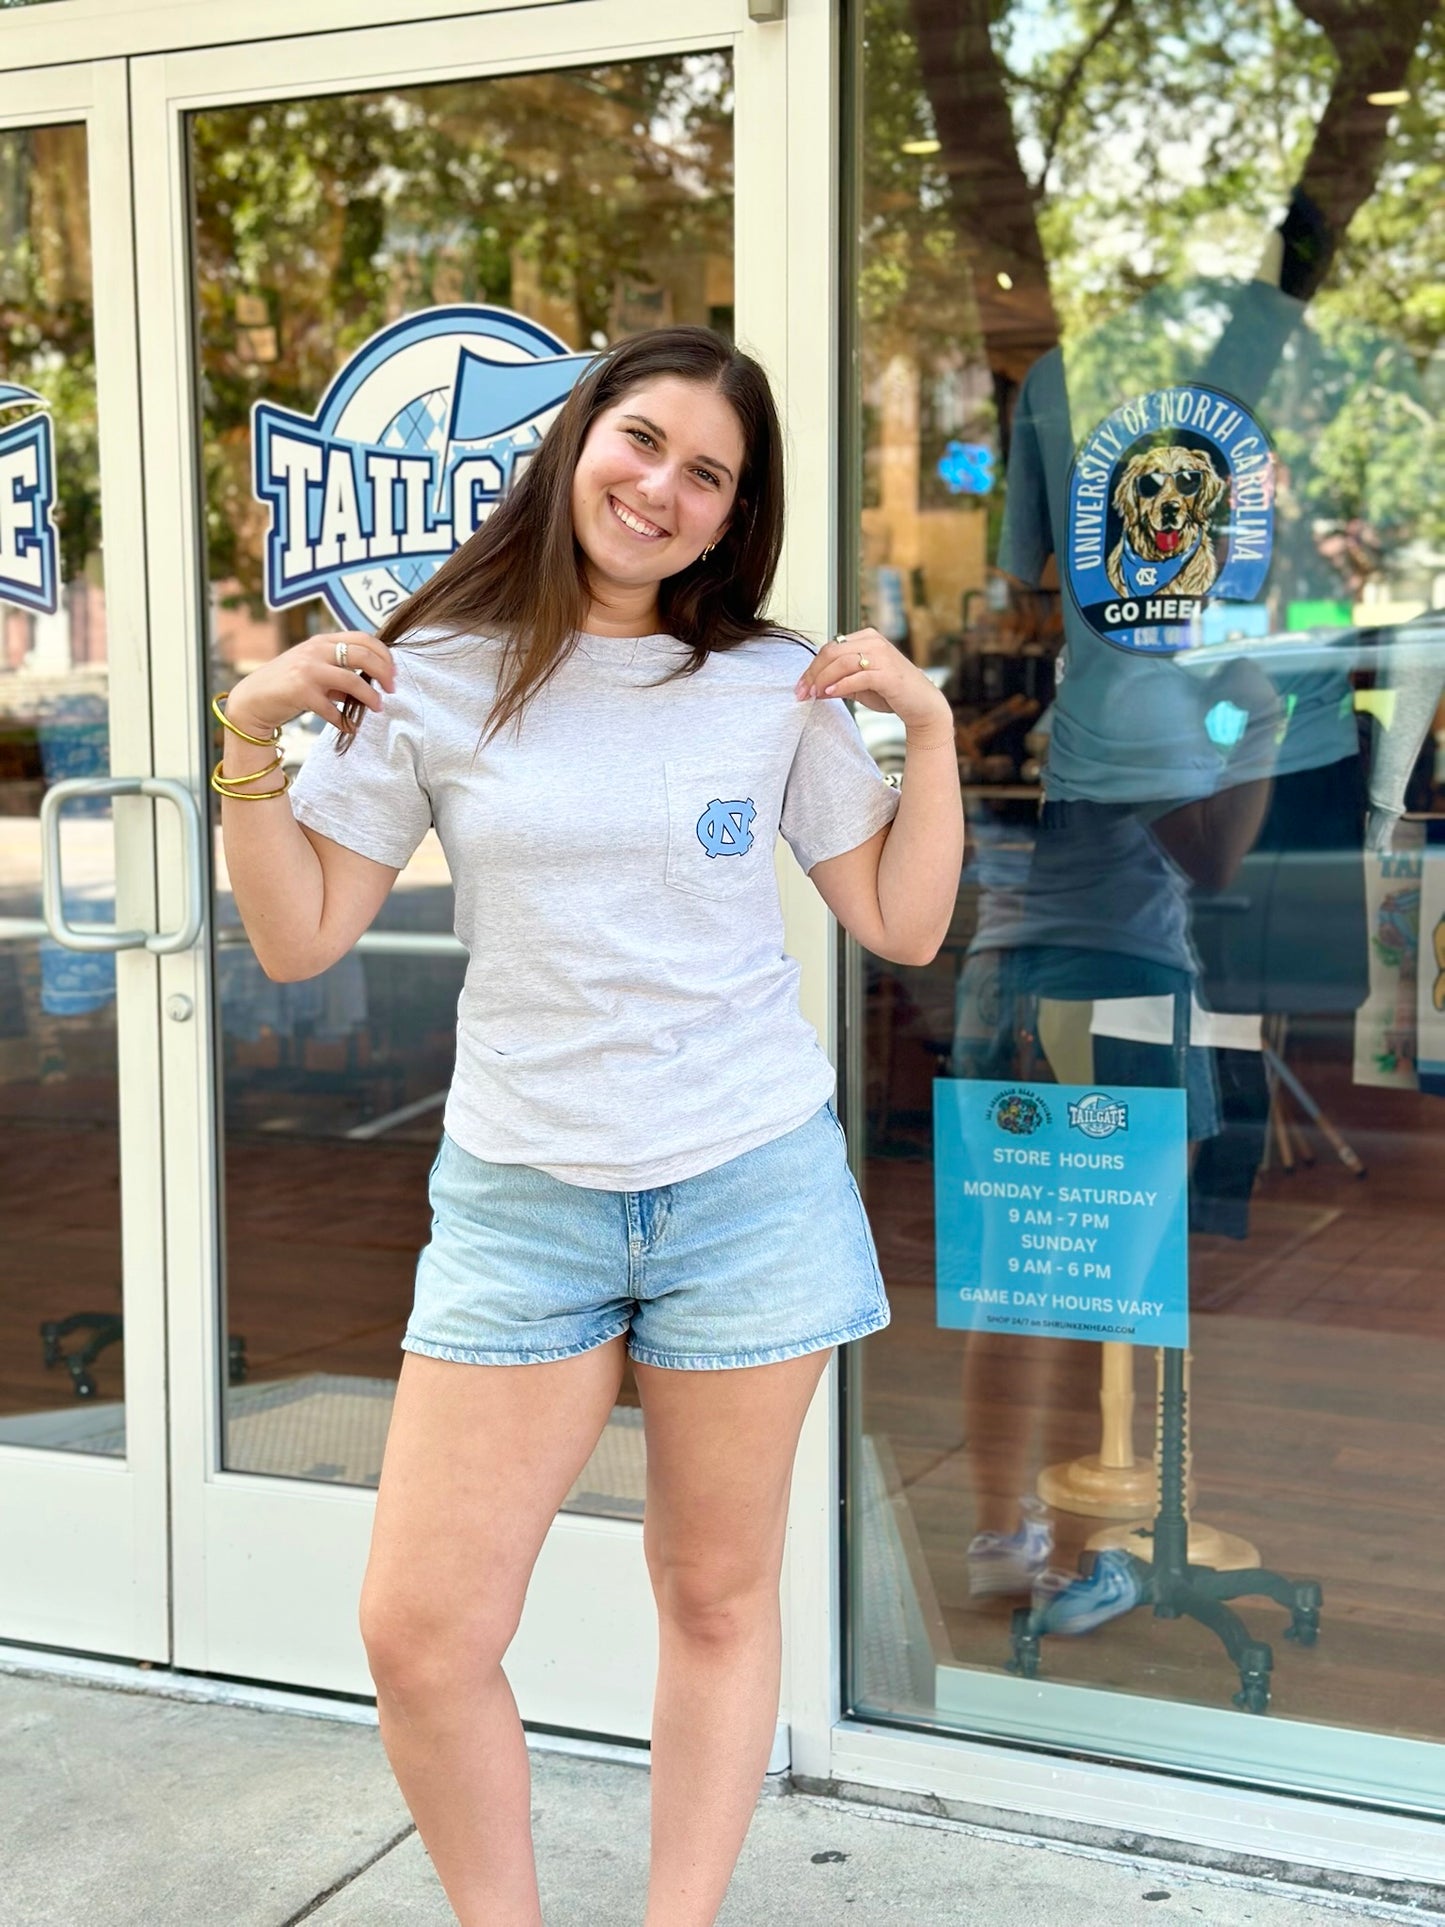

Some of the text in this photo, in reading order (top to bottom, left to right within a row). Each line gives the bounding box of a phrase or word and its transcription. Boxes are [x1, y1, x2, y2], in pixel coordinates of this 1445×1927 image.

[1075, 424, 1122, 571] UNIVERSITY
[1122, 396, 1150, 435] OF
[1160, 391, 1243, 443] NORTH
[1231, 435, 1270, 563] CAROLINA
[271, 434, 533, 579] TAILG
[1104, 602, 1140, 624] GO
[1069, 1106, 1126, 1128] TAILGATE
[993, 1148, 1124, 1170] STORE HOURS
[964, 1181, 1043, 1200] MONDAY
[1058, 1187, 1157, 1206] SATURDAY
[1009, 1209, 1020, 1223] 9
[1024, 1210, 1052, 1225] AM
[1067, 1213, 1077, 1227] 7
[1082, 1214, 1109, 1229] PM
[1021, 1234, 1097, 1253] SUNDAY
[1008, 1258, 1020, 1273] 9
[1024, 1259, 1052, 1275] AM
[1068, 1262, 1079, 1277] 6
[1084, 1263, 1111, 1279] PM
[960, 1287, 1163, 1317] GAME DAY HOURS VARY
[987, 1315, 1010, 1325] SHOP
[1042, 1320, 1135, 1335] SHRUNKENHEAD.COM
